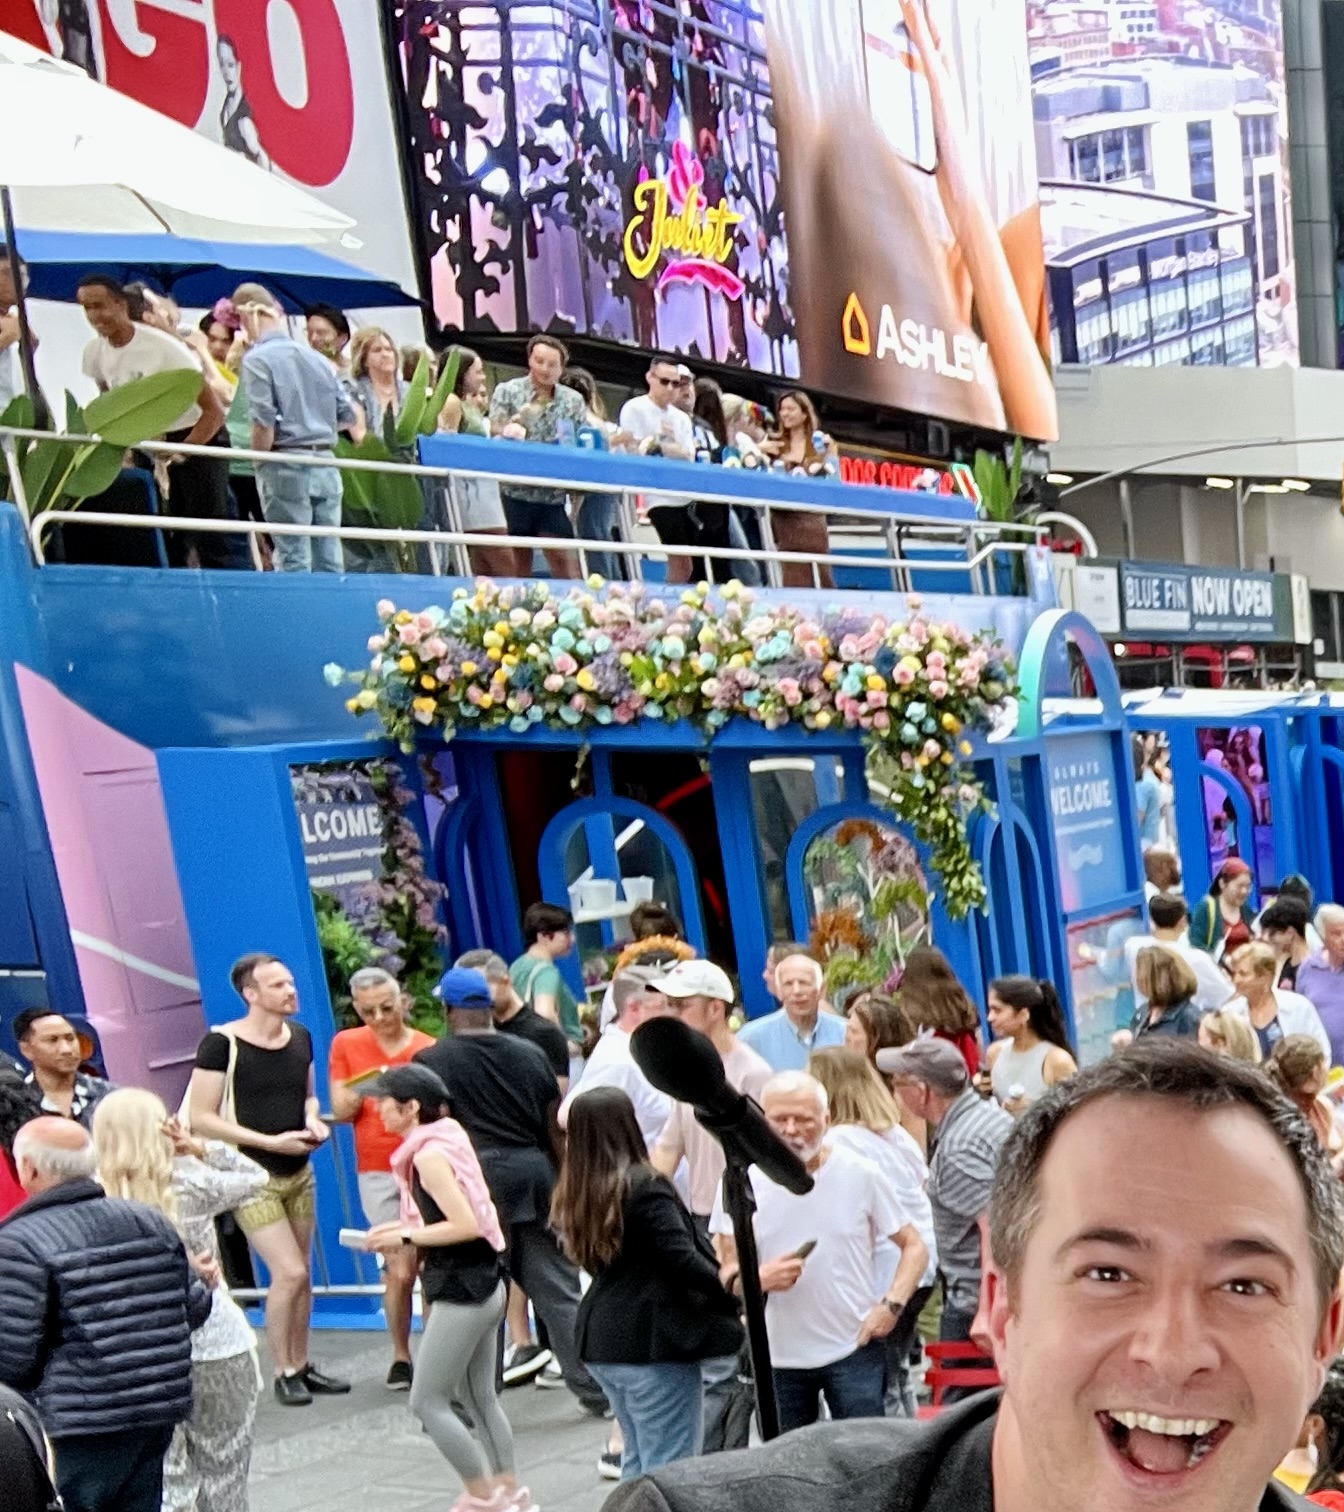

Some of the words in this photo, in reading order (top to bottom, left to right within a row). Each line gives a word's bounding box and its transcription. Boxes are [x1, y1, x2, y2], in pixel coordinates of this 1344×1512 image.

[623, 179, 744, 279] Juliet
[876, 304, 988, 385] ASHLEY
[1126, 576, 1161, 608] BLUE
[1164, 578, 1188, 608] FIN
[1191, 576, 1230, 616] NOW
[1232, 578, 1273, 617] OPEN
[300, 803, 384, 844] LCOME
